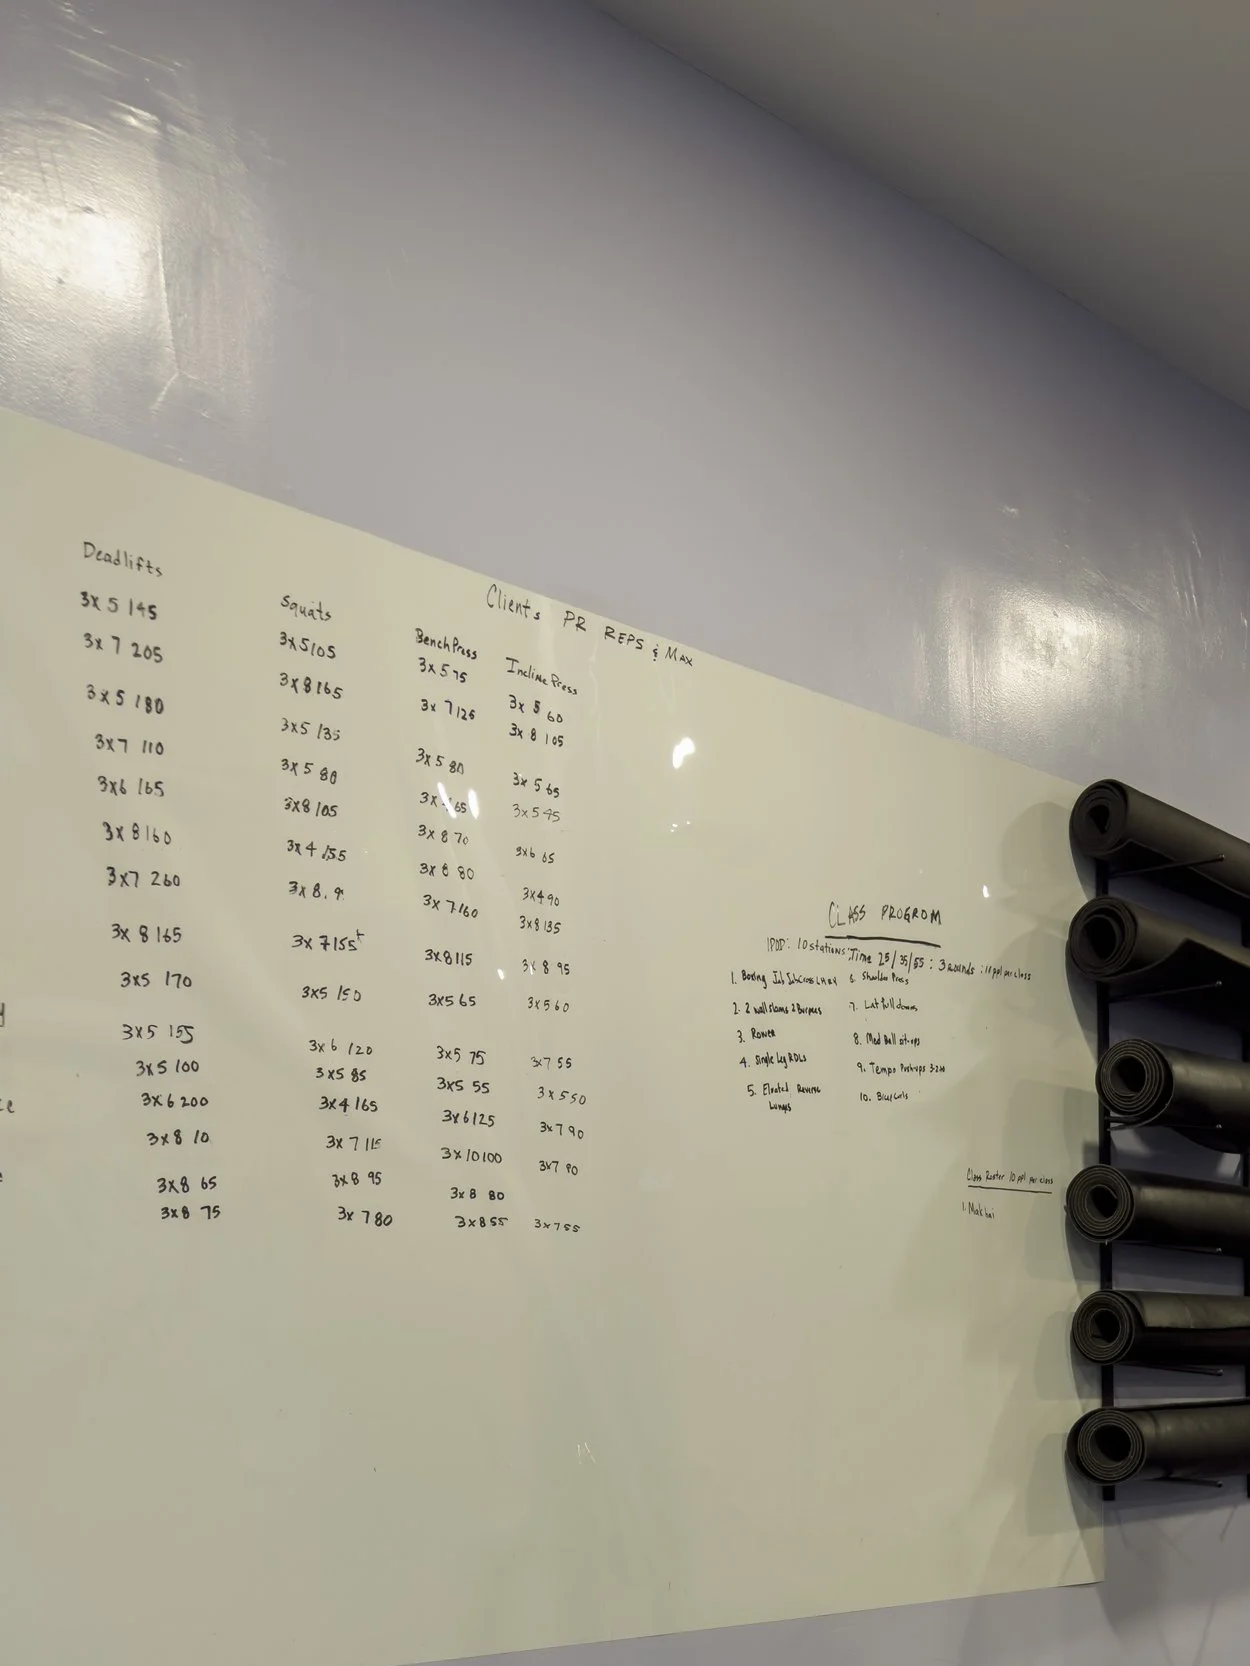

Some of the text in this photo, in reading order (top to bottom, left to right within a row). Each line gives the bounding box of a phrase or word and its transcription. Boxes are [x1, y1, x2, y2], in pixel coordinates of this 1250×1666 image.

[83, 540, 164, 578] Deadlifts
[280, 594, 332, 622] Squats
[562, 609, 587, 633] PR
[603, 625, 645, 651] REPS
[868, 1060, 897, 1078] Tempo
